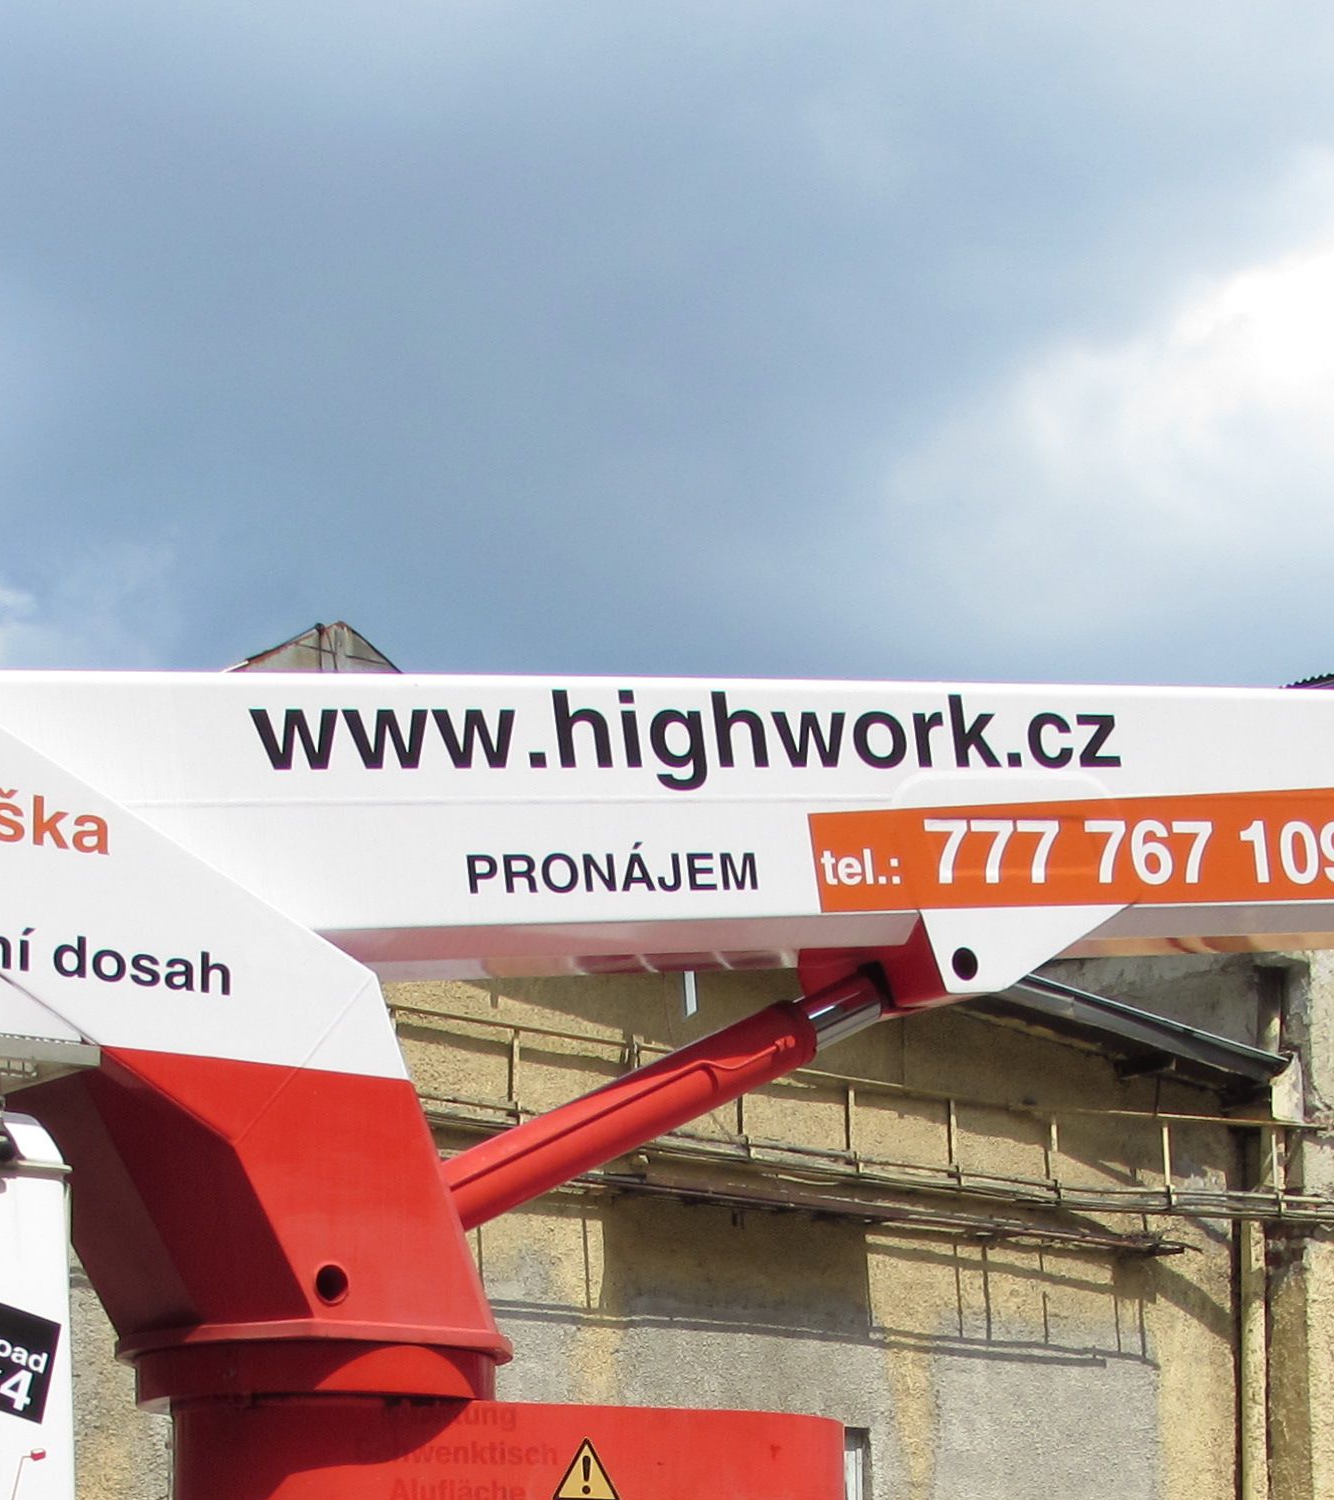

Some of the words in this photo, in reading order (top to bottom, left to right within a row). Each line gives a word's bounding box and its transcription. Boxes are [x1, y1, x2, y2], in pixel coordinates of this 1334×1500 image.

[248, 688, 1122, 791] www.highwork.cz
[466, 842, 759, 895] PRONÁJEM
[820, 848, 902, 886] tel.:
[922, 819, 1060, 885] 777
[1083, 818, 1213, 885] 767
[53, 935, 231, 996] dosah
